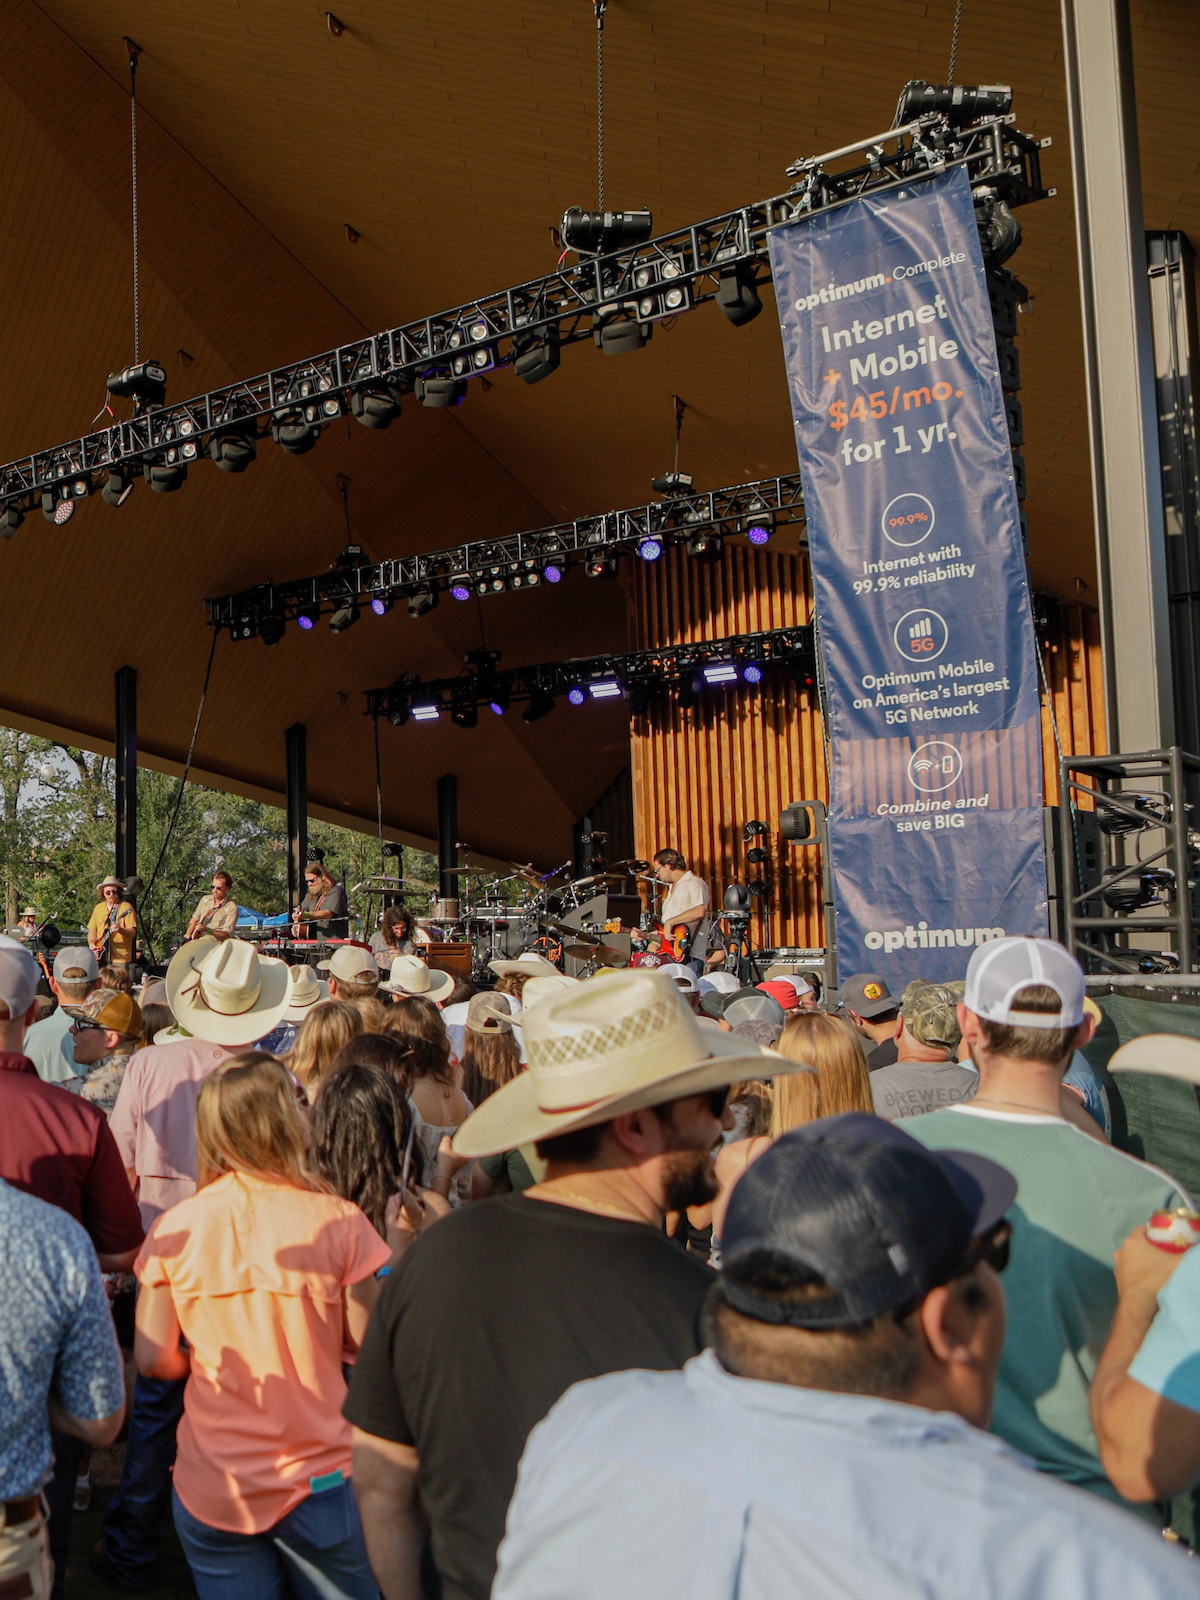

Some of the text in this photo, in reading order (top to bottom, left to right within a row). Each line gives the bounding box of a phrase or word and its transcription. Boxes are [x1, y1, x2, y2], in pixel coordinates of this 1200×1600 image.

[892, 251, 965, 281] Complete
[821, 294, 949, 353] Internet
[849, 336, 959, 385] Mobile
[828, 381, 964, 432] $45/mo.
[842, 421, 958, 466] for 1 yr.
[888, 511, 929, 528] 99.9%
[863, 544, 961, 575] Internet with
[853, 562, 976, 595] 99.9% reliability
[910, 637, 935, 653] 5G
[861, 658, 995, 690] Optimum Mobile
[853, 676, 1010, 709] on America's largest
[885, 701, 980, 725] 5G Network
[876, 794, 989, 816] Combine and
[896, 813, 965, 833] save BIG
[864, 921, 1006, 953] optimum
[884, 1088, 962, 1107] BREWED
